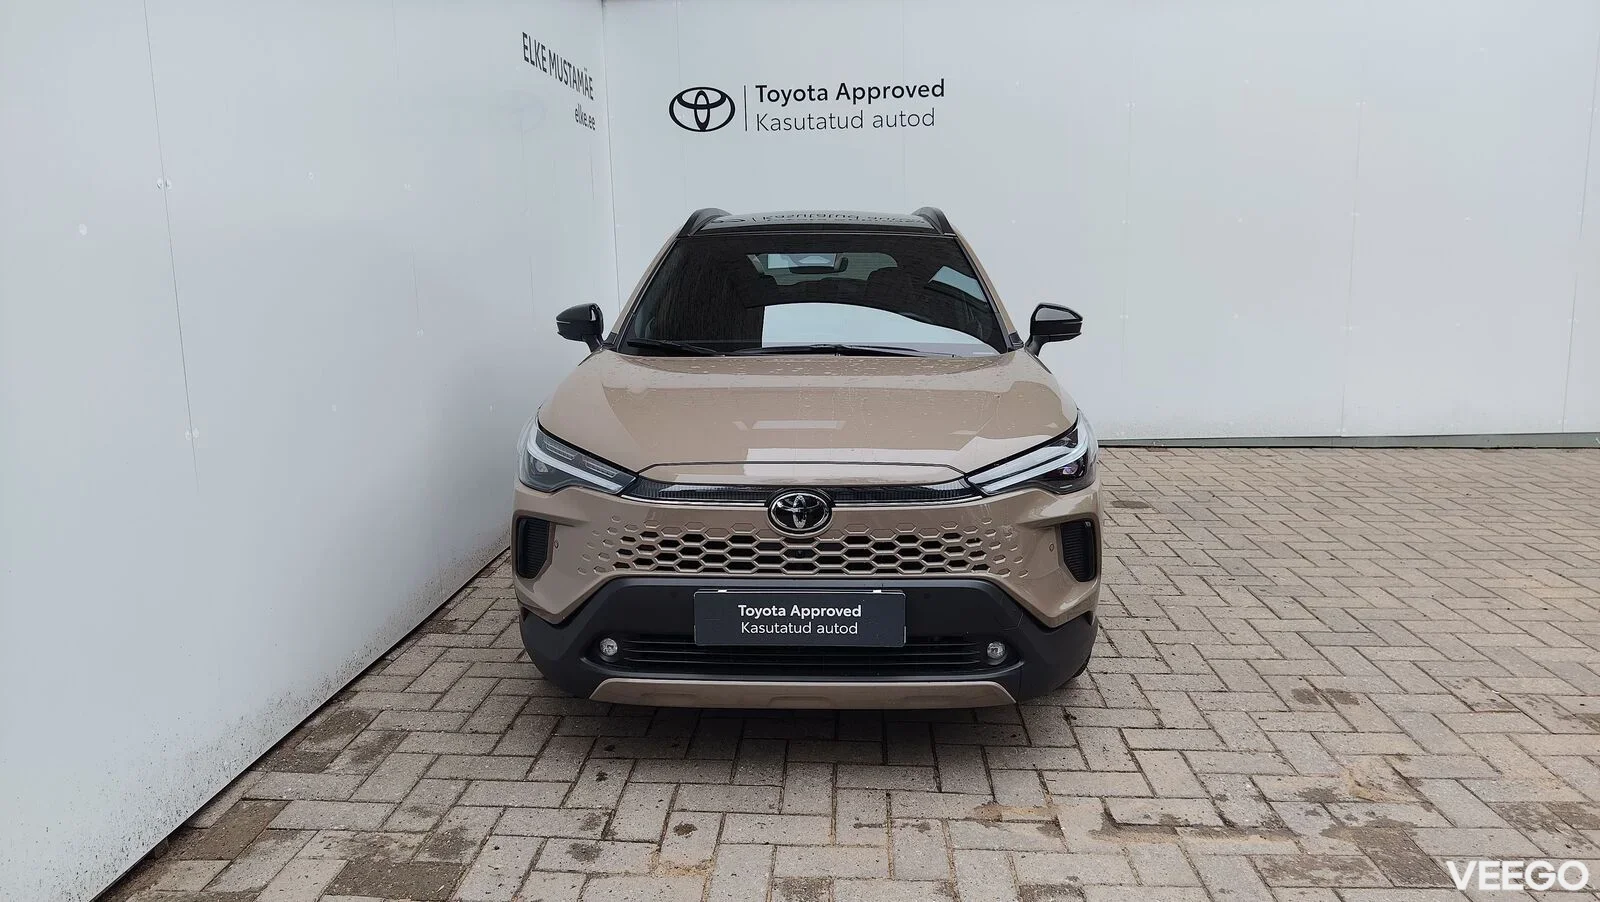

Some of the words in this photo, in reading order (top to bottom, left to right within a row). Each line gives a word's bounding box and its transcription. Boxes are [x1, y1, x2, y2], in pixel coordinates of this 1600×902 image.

[522, 31, 547, 73] ELKE
[548, 49, 594, 101] MUSTAMÄE
[755, 84, 828, 107] Toyota
[836, 78, 945, 105] Approved
[574, 102, 596, 131] elke.ee
[756, 110, 864, 132] Kasutatud
[872, 107, 935, 128] autod
[737, 604, 786, 620] Toyota
[790, 604, 862, 620] Approved
[741, 621, 812, 635] Kasutatud
[816, 621, 858, 635] autod
